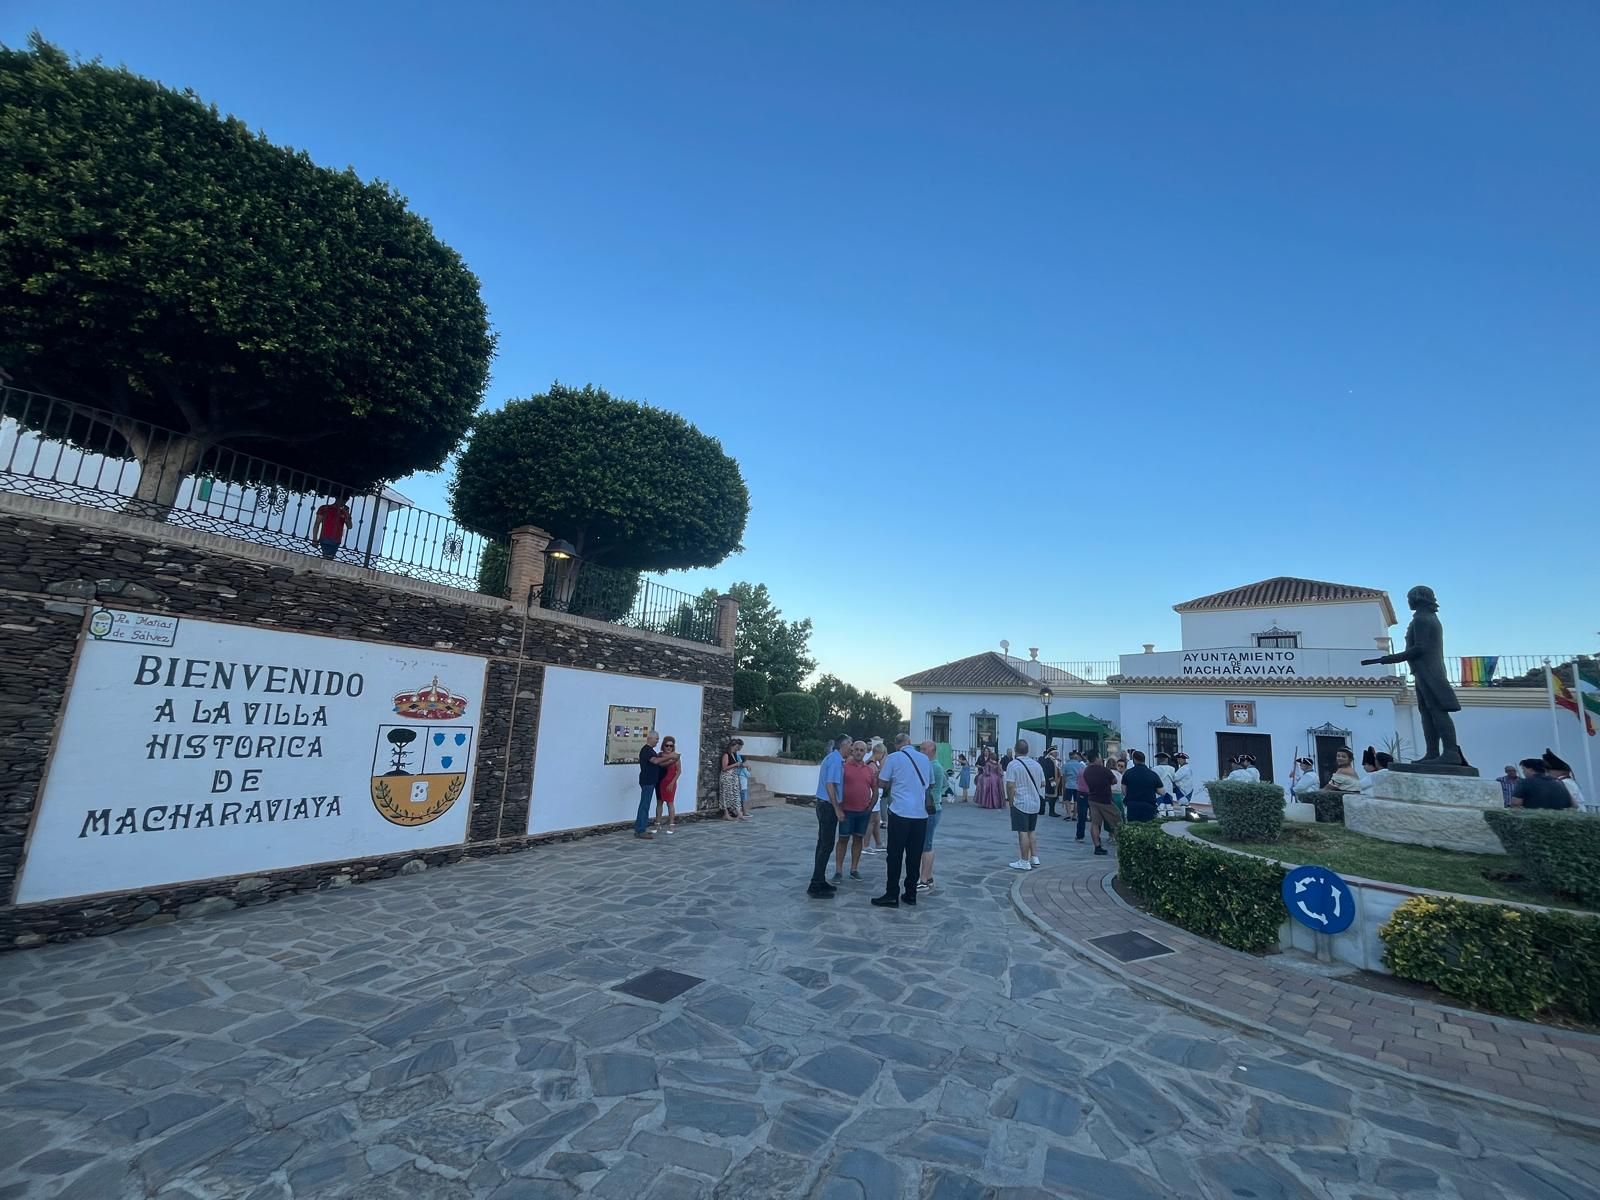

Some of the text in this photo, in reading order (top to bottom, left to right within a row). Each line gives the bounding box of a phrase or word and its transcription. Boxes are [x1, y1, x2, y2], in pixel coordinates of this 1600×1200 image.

[112, 628, 125, 637] de
[1183, 652, 1295, 662] AYUNTAMIENTO
[133, 655, 364, 697] BIENVENIDO
[1183, 666, 1296, 675] MACHARAVIAYA
[153, 699, 328, 727] A LA VILLA
[146, 733, 323, 760] HISTORICA
[211, 769, 263, 793] DE
[78, 795, 342, 838] MACHARAVIAYA
